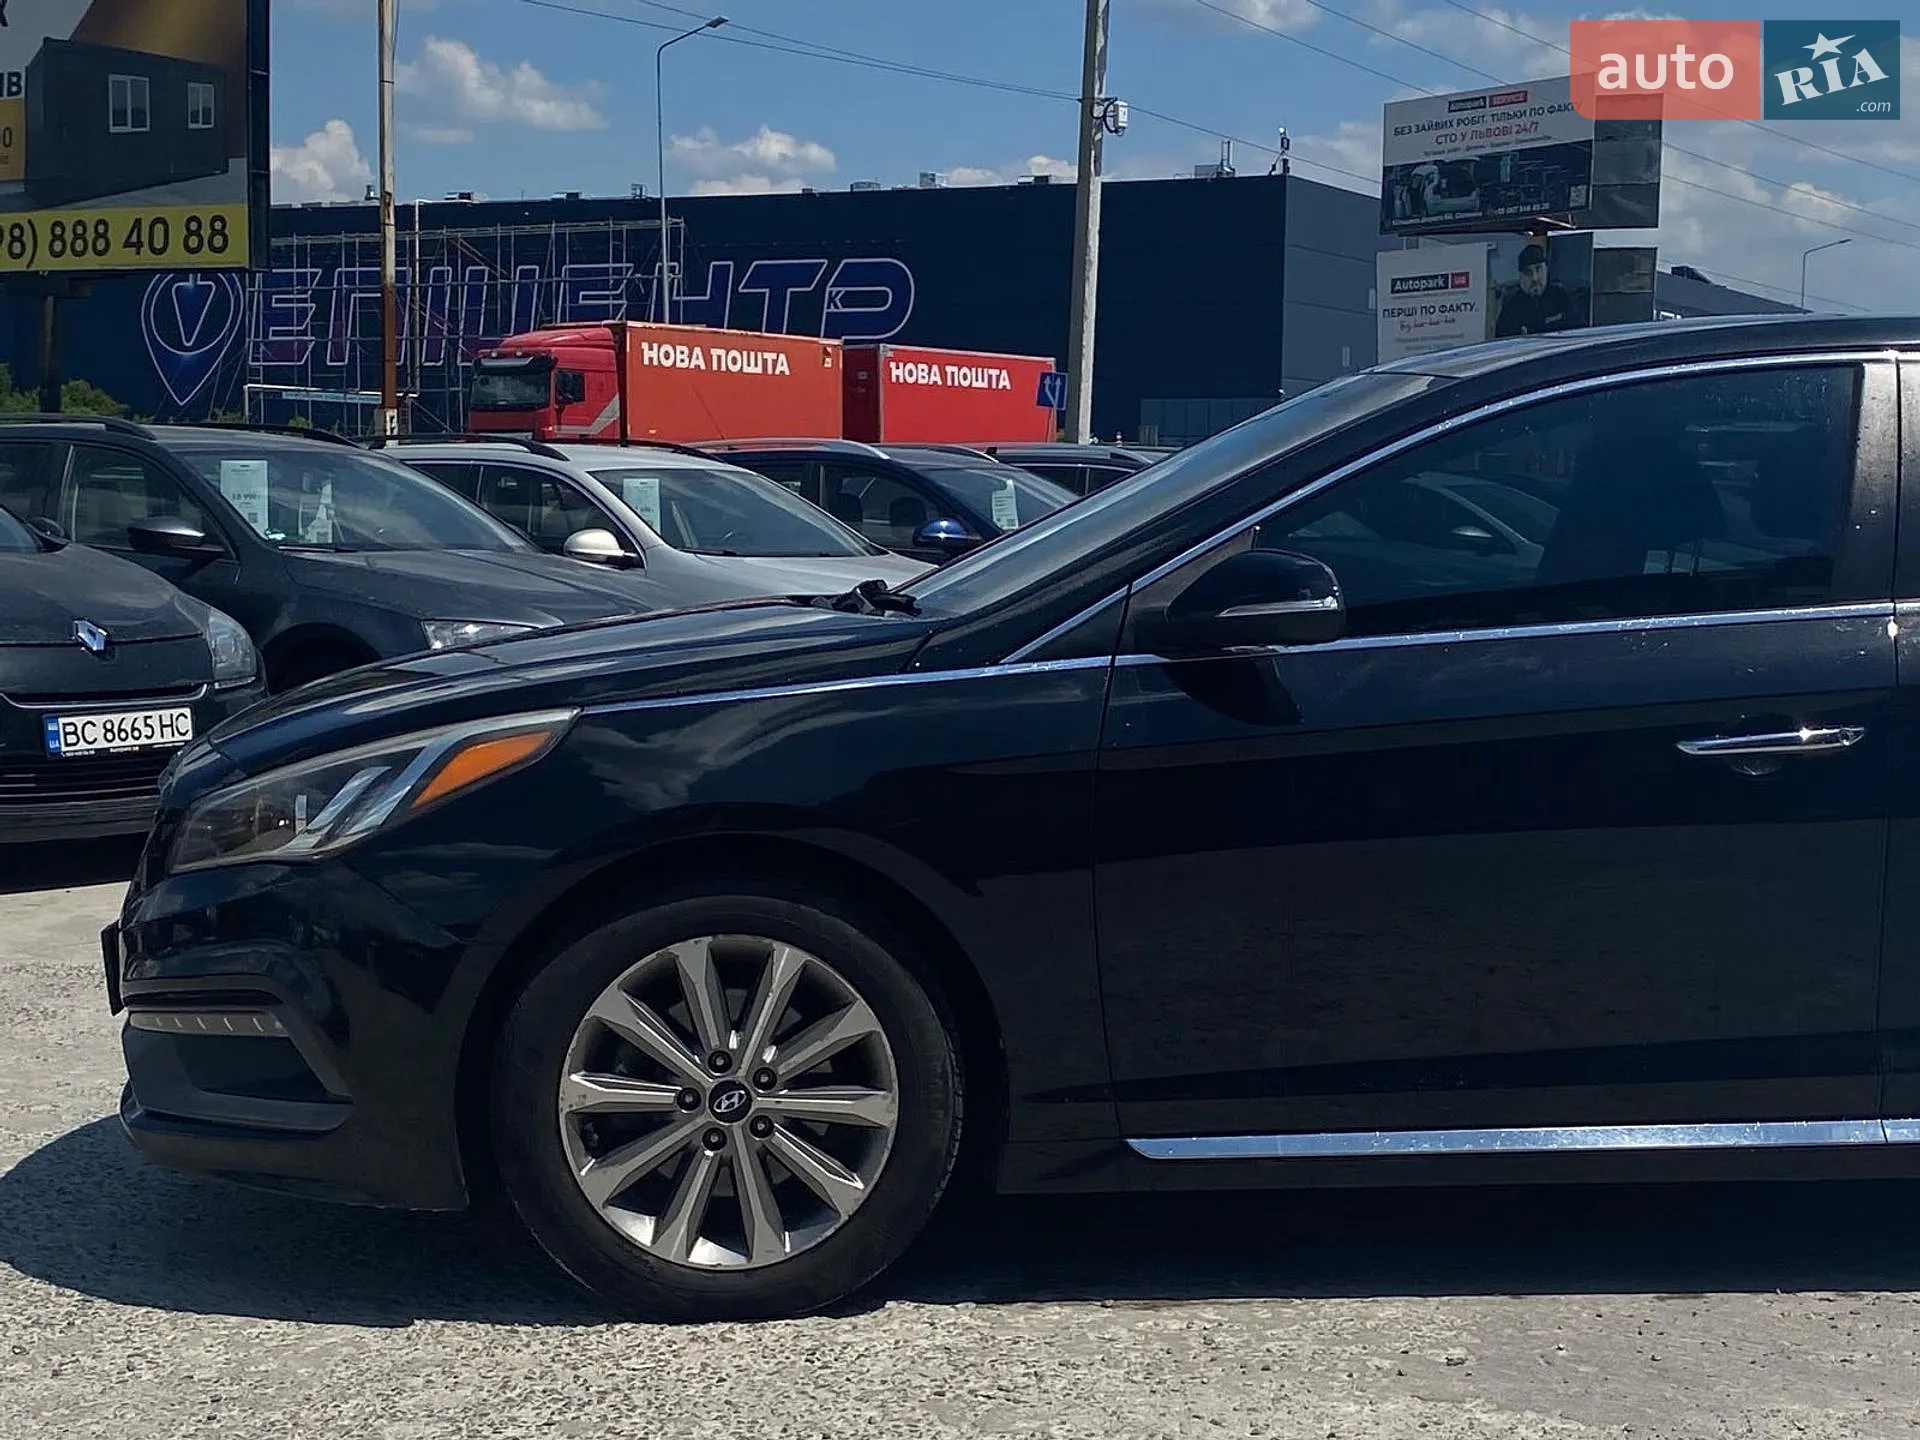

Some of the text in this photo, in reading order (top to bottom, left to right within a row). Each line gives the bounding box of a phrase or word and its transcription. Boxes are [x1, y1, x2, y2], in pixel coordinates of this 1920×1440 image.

[1393, 124, 1413, 137] БЕЗ
[1414, 119, 1454, 134] ЗАЙВИХ
[1529, 106, 1546, 118] ПО
[1435, 121, 1540, 145] СТО У ЛЬВОВІ 24/7
[0, 214, 229, 268] 8) 888 40 88
[1394, 275, 1445, 290] Autopark
[1382, 306, 1417, 318] ПЕРШІ
[1420, 305, 1436, 315] ПО
[641, 341, 792, 377] НОВА ПОШТА
[889, 361, 1012, 391] НОВА ПОШТА
[62, 712, 190, 748] BC 8665 HC
